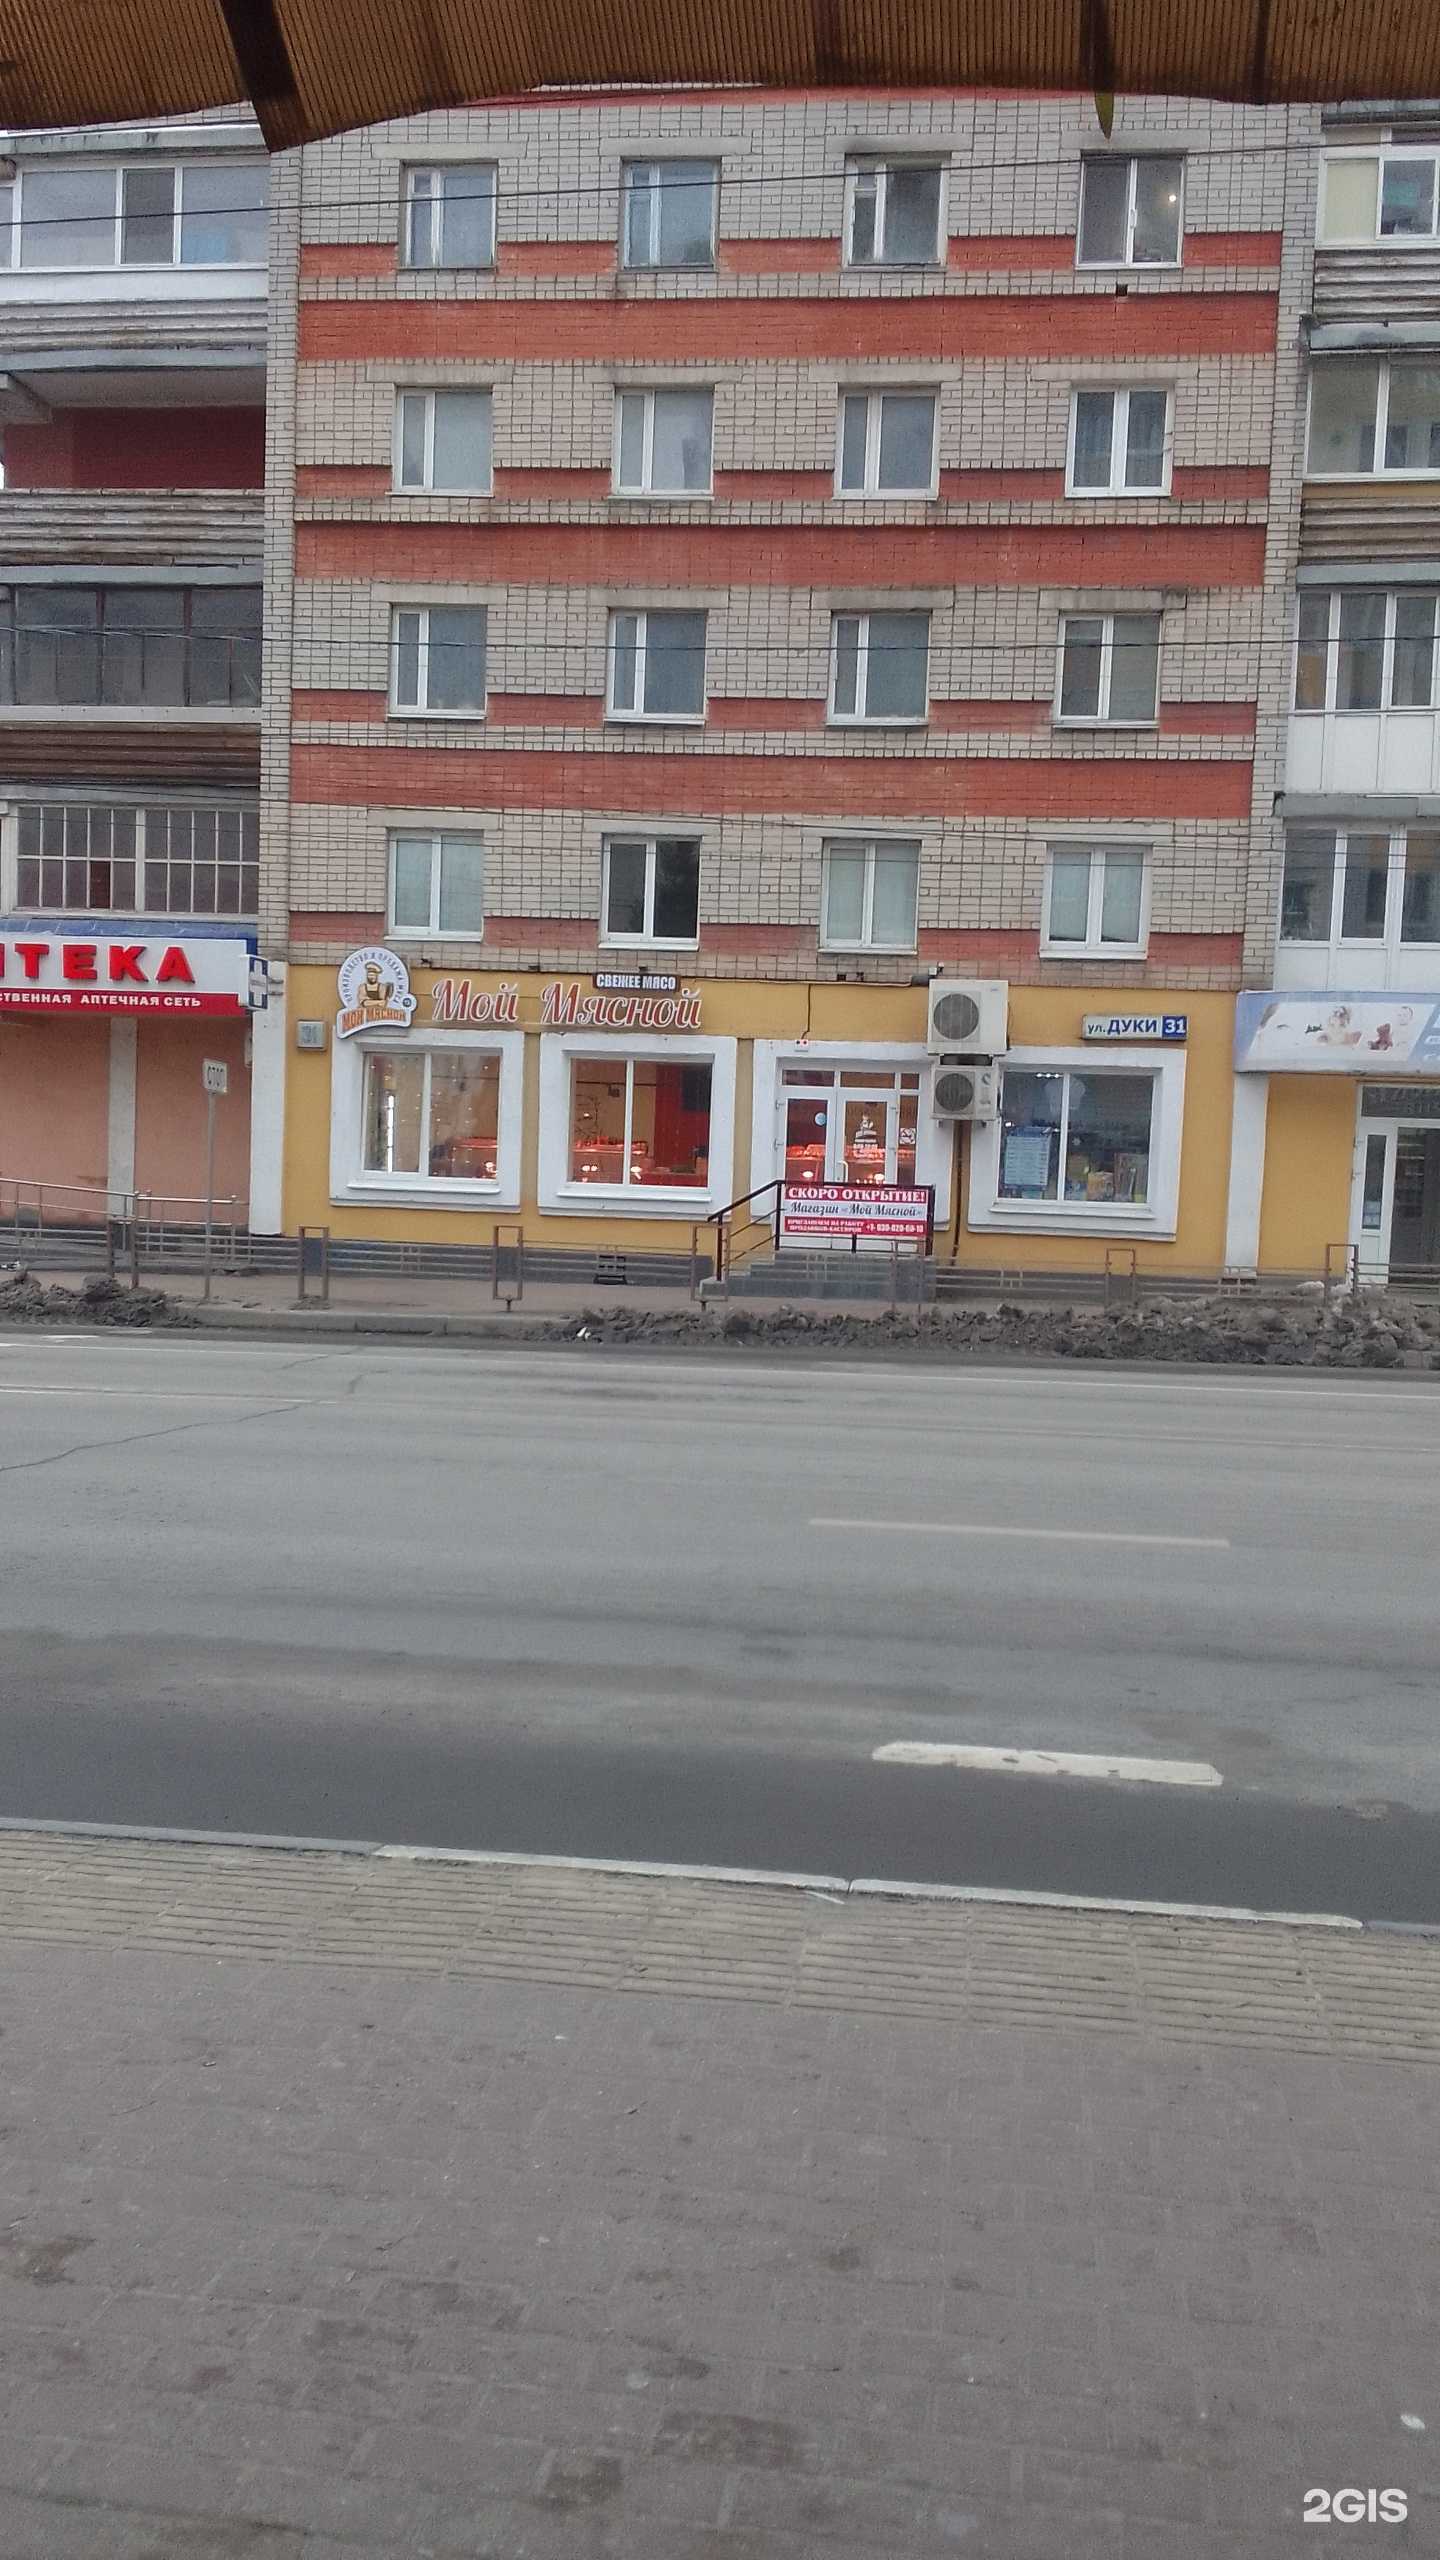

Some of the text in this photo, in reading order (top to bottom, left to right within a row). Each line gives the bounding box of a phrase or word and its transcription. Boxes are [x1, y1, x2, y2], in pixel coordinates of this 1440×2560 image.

[0, 943, 196, 984] ТЕКА
[596, 974, 676, 991] СВЕЖЕЕ МЯСО
[80, 994, 160, 1006] АПТЕЧНАЯ
[164, 997, 201, 1007] СЕТЬ
[432, 978, 702, 1028] Мой Мясной
[1088, 1018, 1186, 1035] ул. ДУКИ 31
[788, 1187, 926, 1203] СКОРО ОТКРЫТИЕ!
[790, 1202, 840, 1216] Магазин
